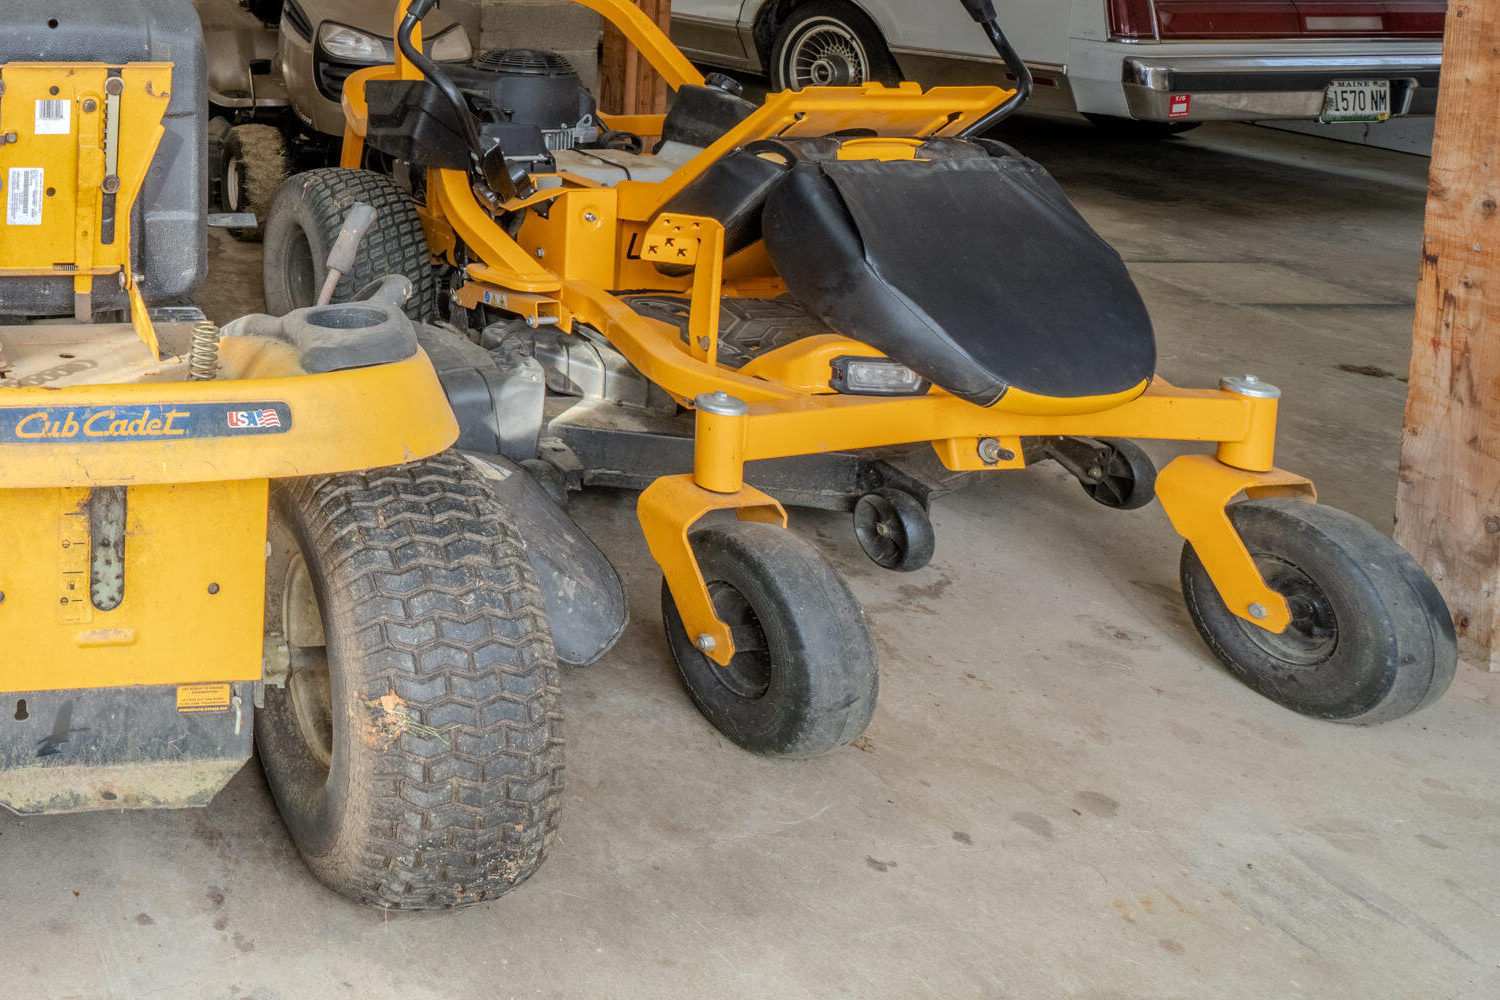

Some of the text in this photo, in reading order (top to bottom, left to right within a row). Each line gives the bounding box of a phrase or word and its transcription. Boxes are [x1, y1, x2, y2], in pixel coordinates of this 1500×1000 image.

[1334, 89, 1387, 112] 1570 NM
[15, 409, 191, 438] Cub Cadet
[227, 411, 260, 428] USA
